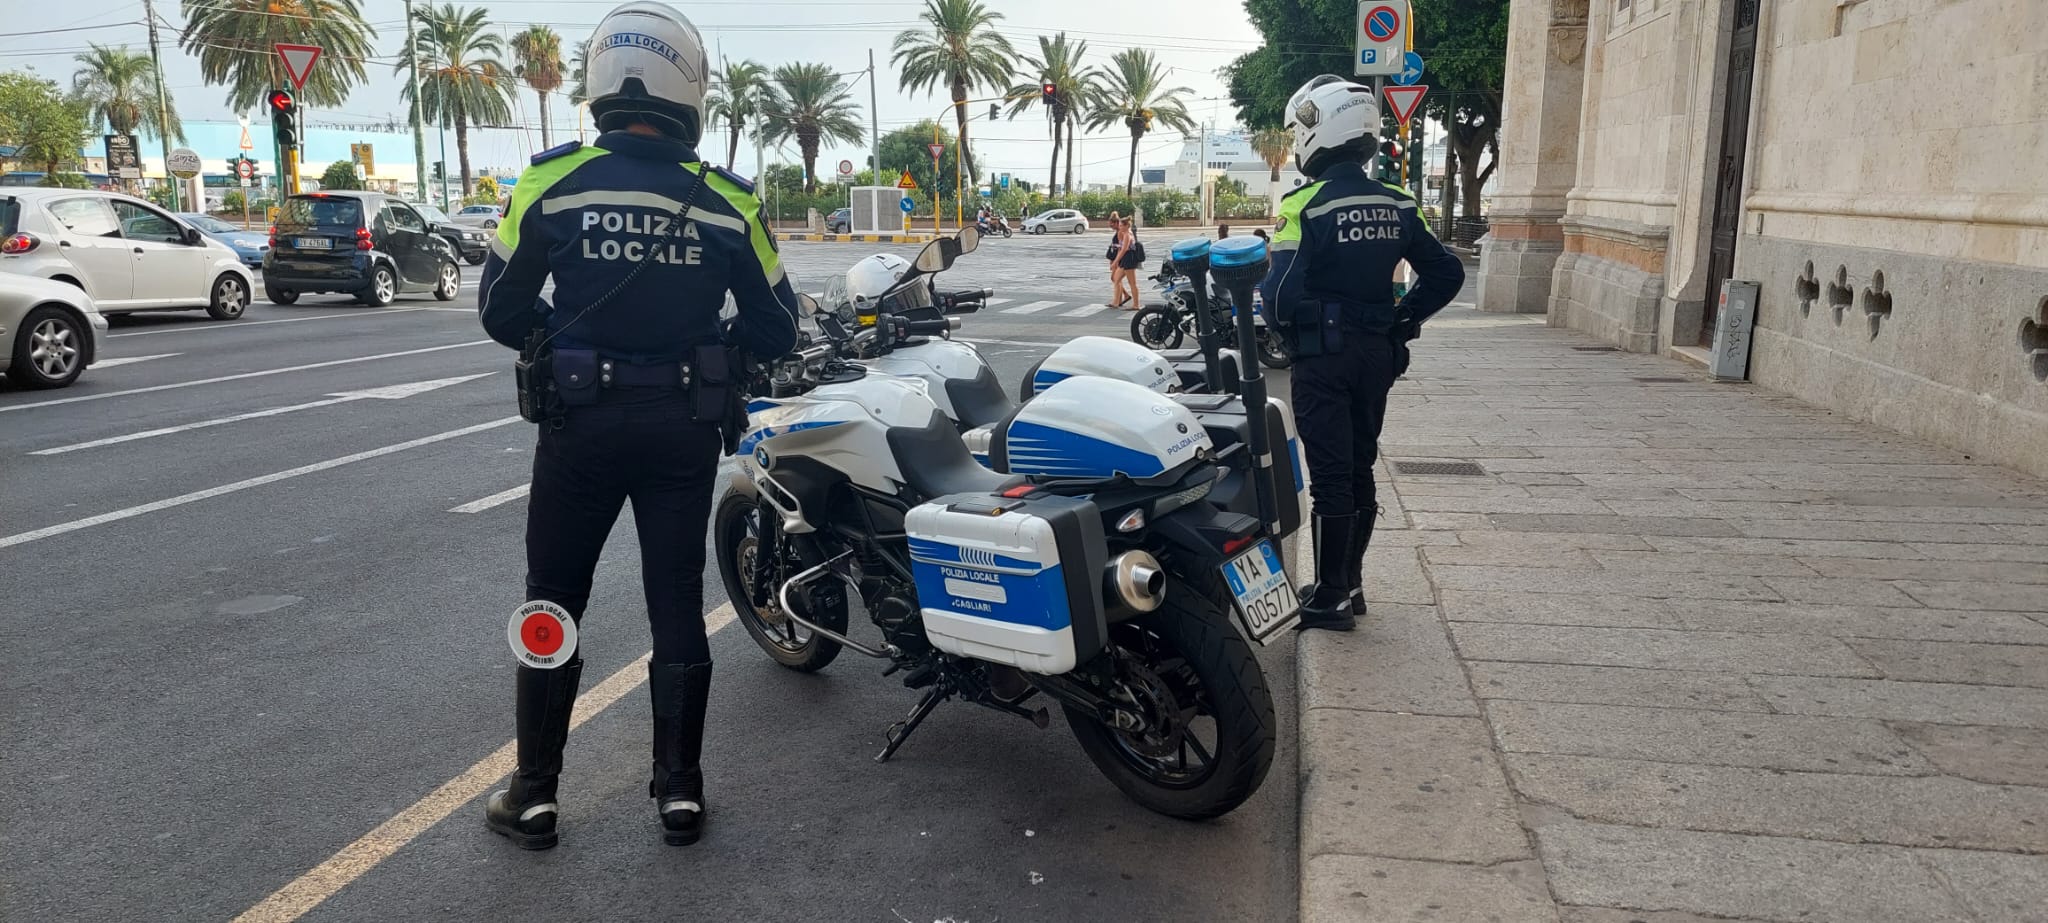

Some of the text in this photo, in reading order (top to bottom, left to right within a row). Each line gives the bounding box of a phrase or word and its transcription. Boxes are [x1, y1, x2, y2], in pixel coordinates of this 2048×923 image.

[595, 36, 680, 62] POLIZIA LOCALE
[1336, 98, 1367, 113] POLIZIA
[1336, 208, 1401, 226] POLIZIA
[1338, 225, 1402, 243] LOCALE
[1167, 438, 1192, 456] POLIZIA
[941, 566, 1000, 583] POLIZIA LOCALE
[1235, 554, 1262, 584] YA
[520, 604, 567, 622] POLIZIA LOCALE
[955, 599, 992, 613] CAGLIARI
[1246, 581, 1292, 629] 00577
[525, 652, 555, 664] CAGLIARI
